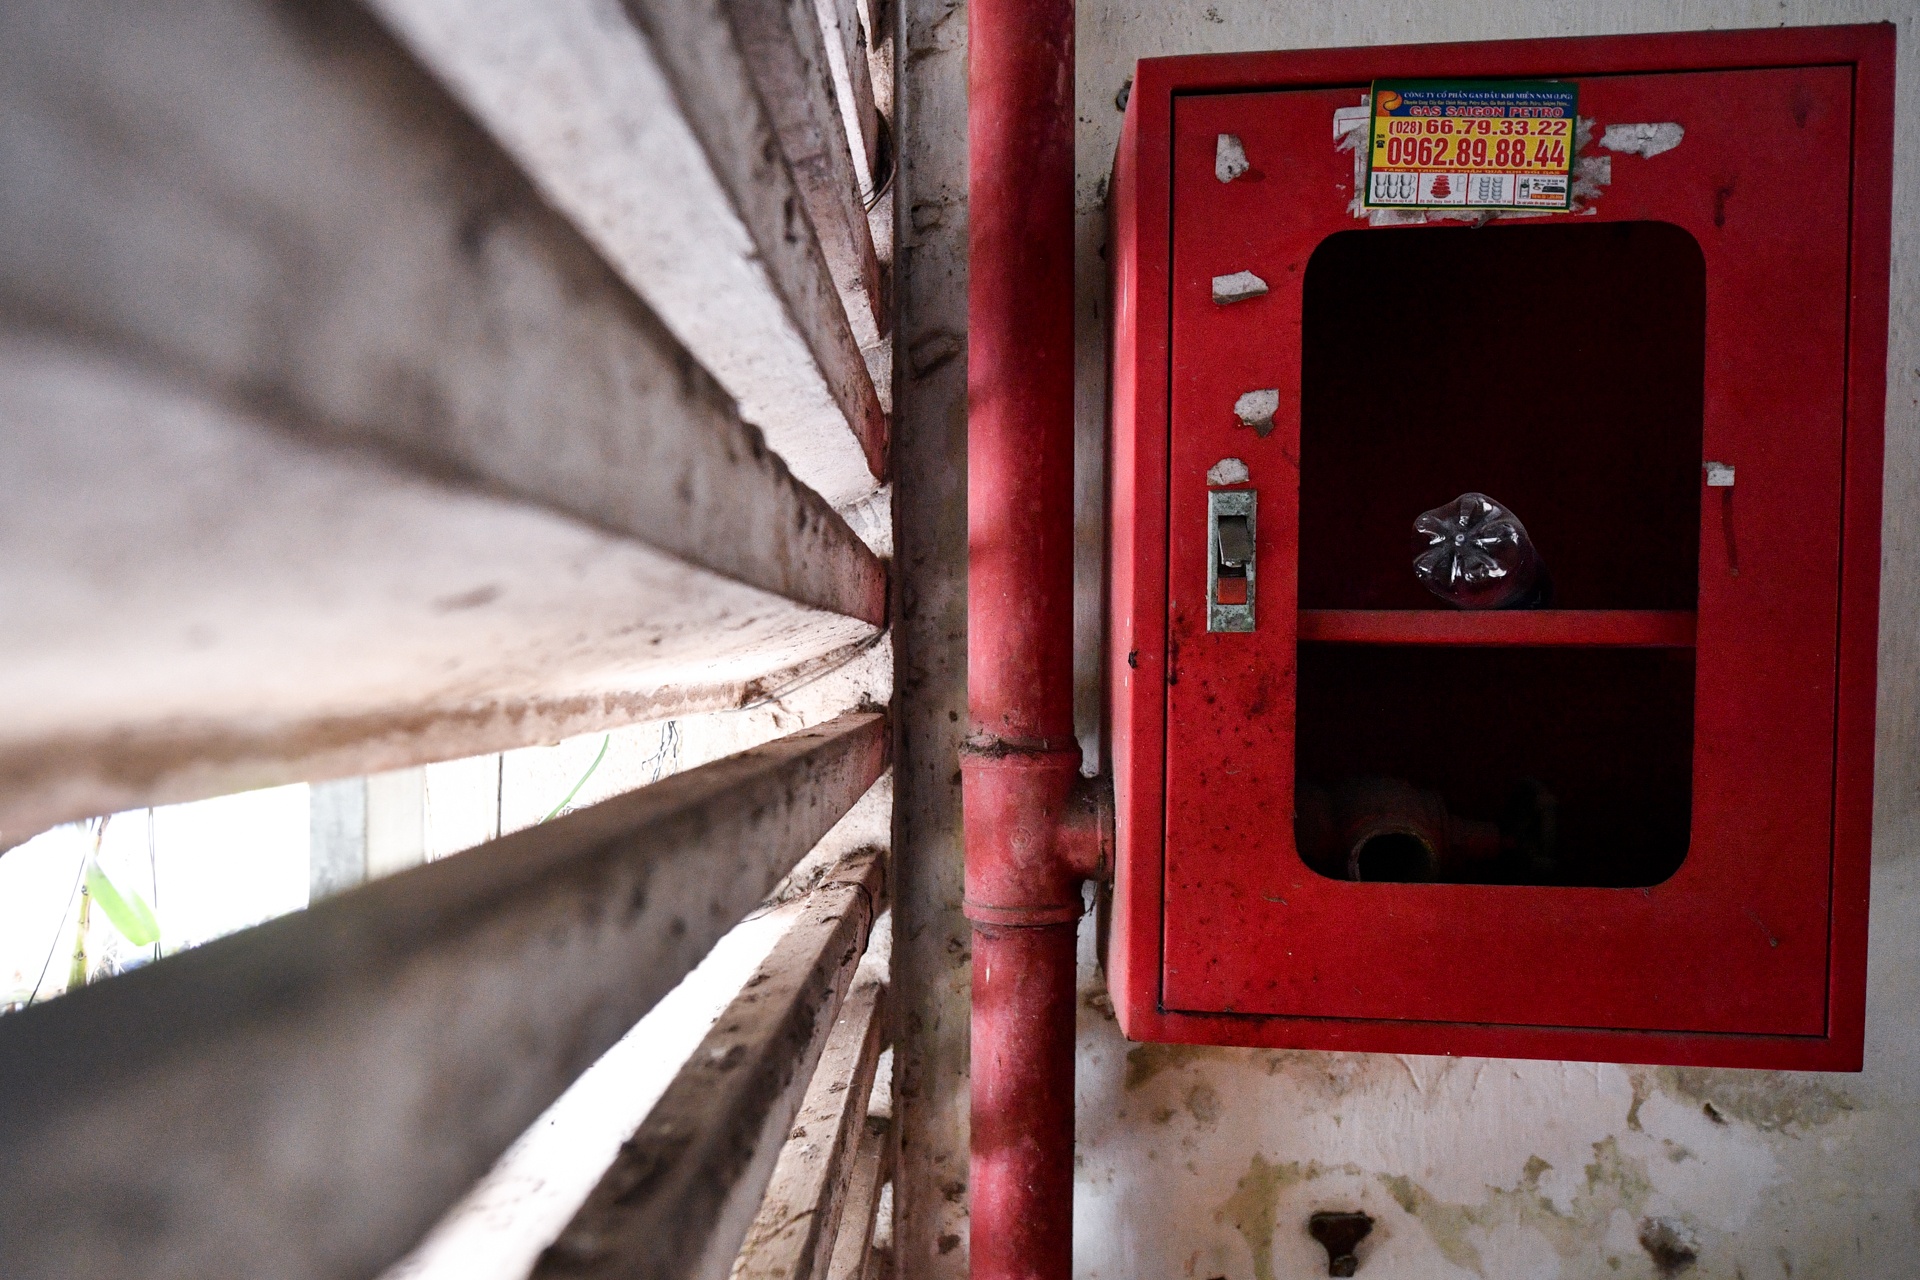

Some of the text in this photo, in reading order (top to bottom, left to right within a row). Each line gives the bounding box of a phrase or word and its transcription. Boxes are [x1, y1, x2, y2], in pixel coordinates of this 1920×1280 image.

[1410, 106, 1564, 117] GAS SAIGON PETRO
[1389, 119, 1567, 136] (028) 66.79.33.22
[1387, 137, 1565, 168] 0962.89.88.44
